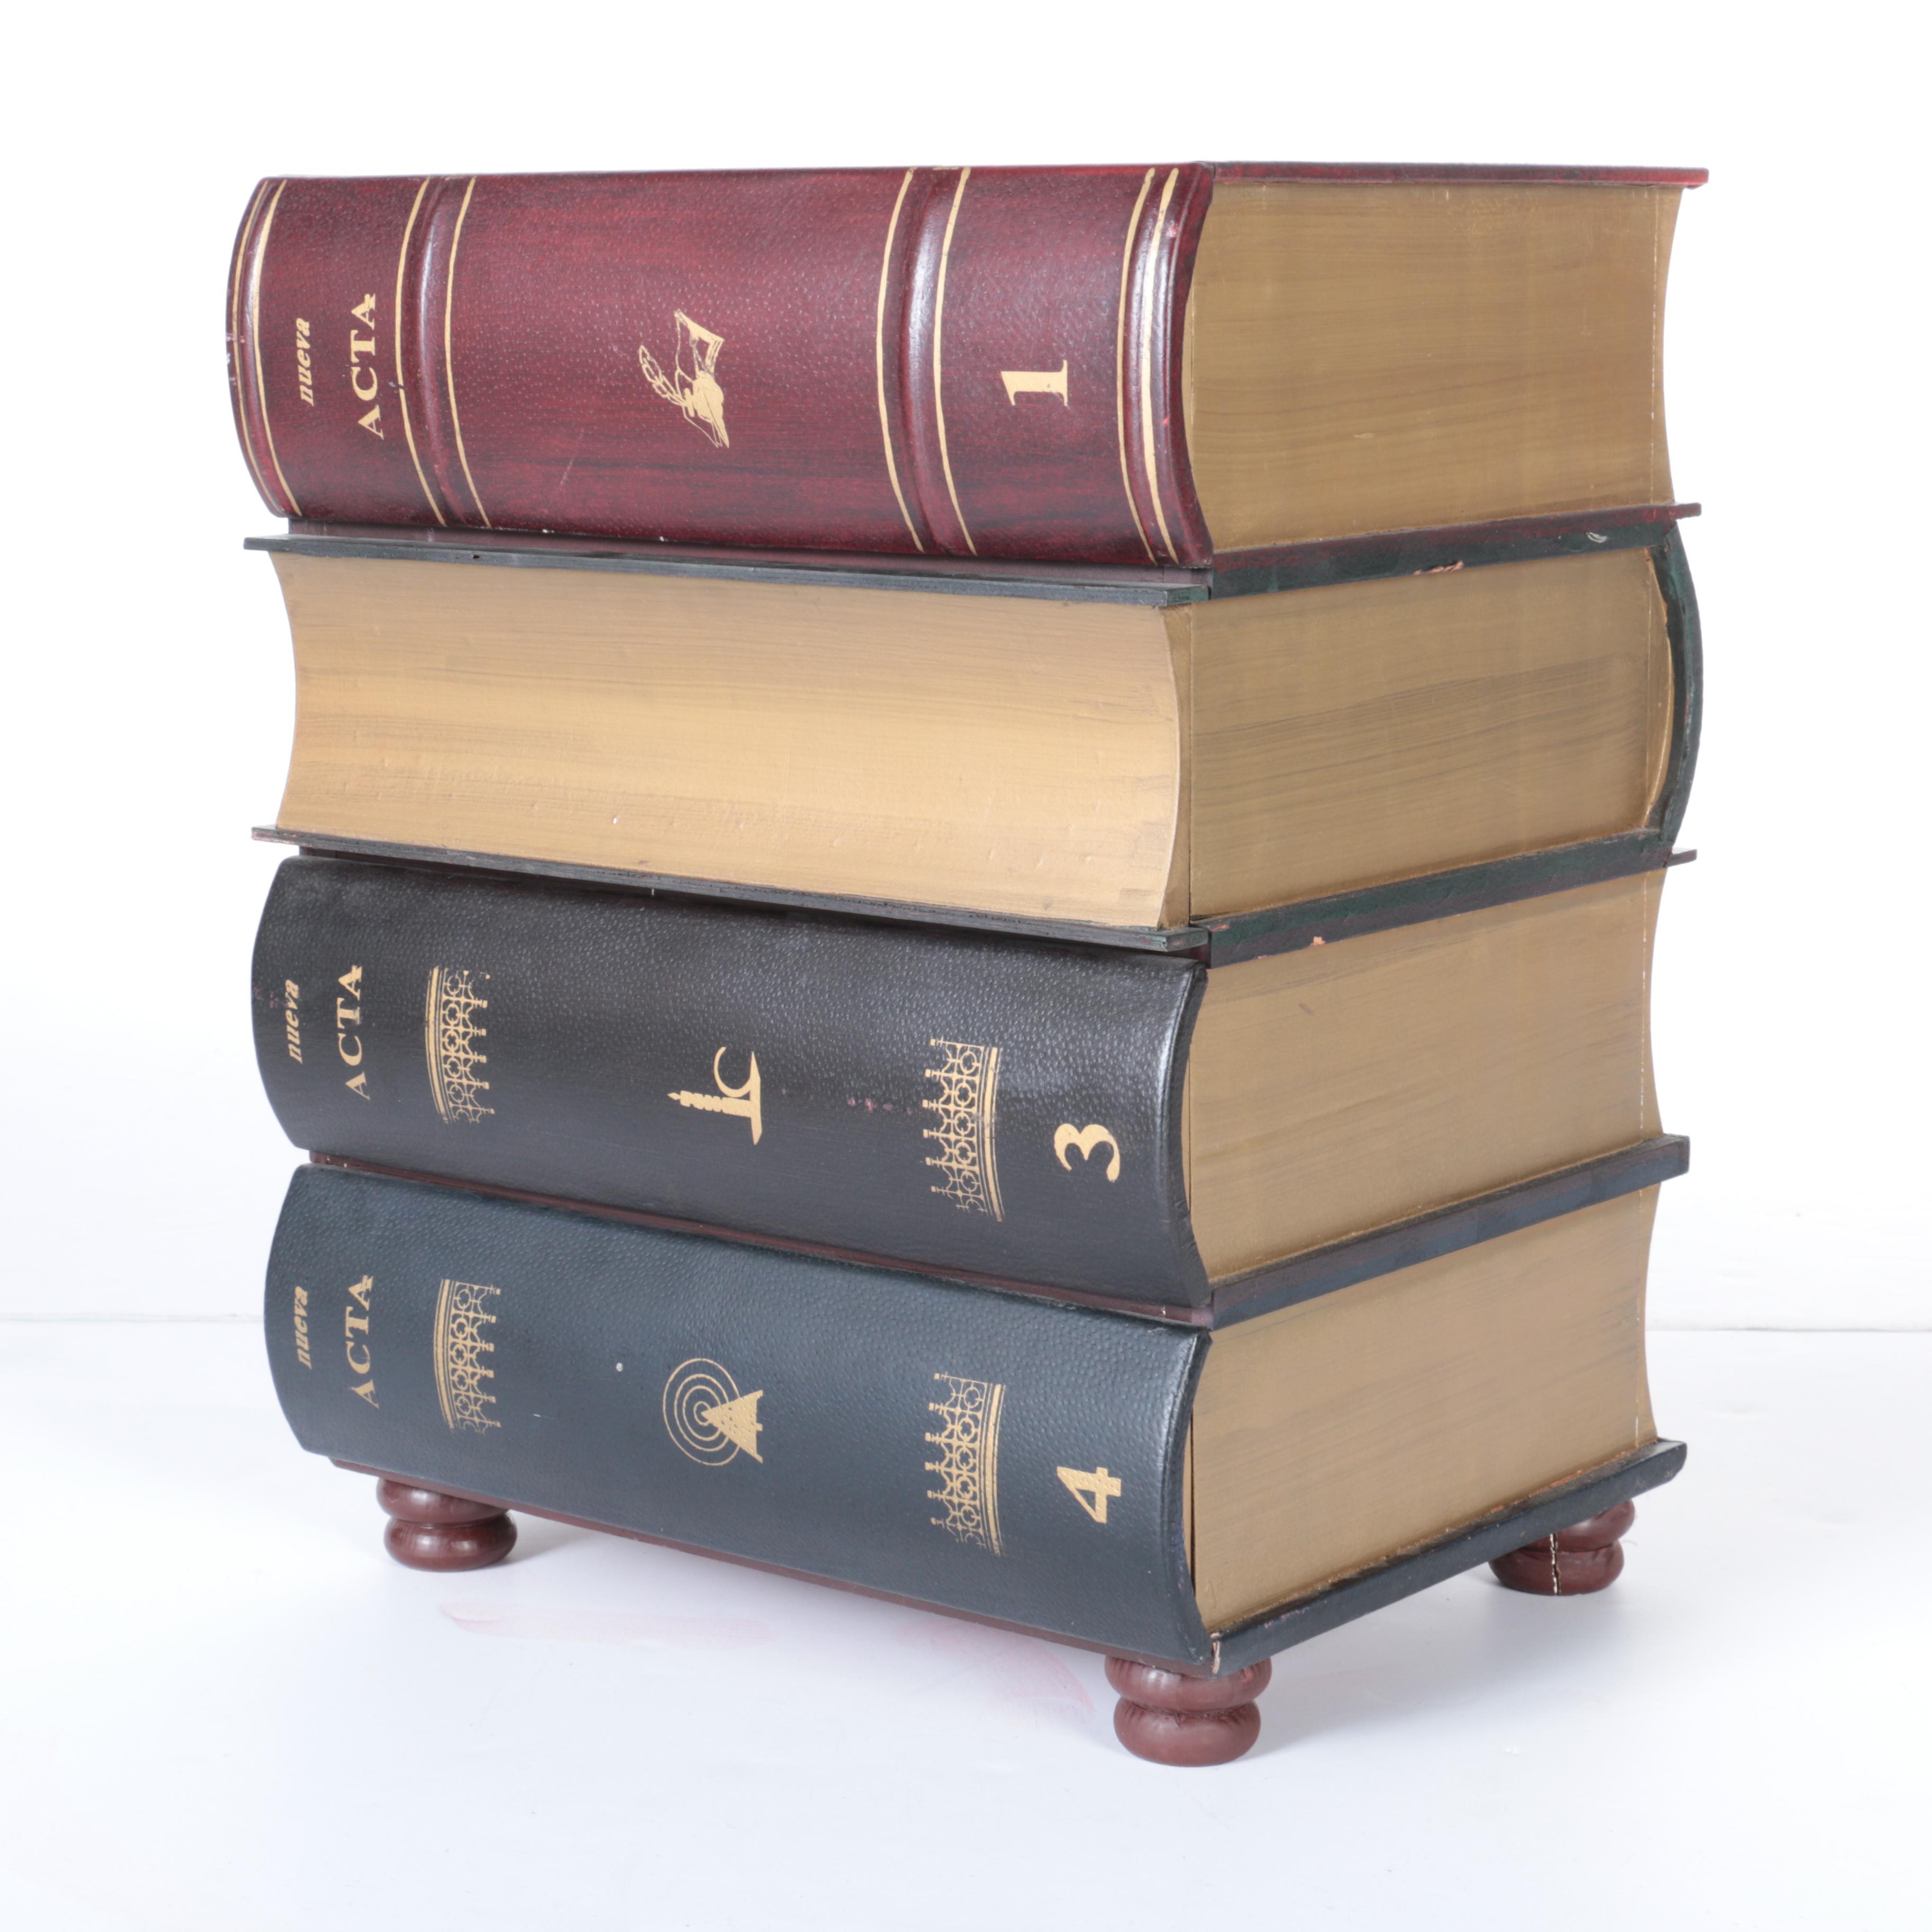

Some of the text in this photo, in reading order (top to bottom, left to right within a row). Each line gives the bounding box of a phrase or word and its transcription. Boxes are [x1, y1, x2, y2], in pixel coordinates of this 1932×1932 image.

[296, 318, 314, 406] nueva
[350, 293, 383, 440] ACTA
[999, 359, 1069, 408] 1
[284, 979, 302, 1063] nueva
[337, 965, 370, 1100] ACTA
[1054, 1123, 1121, 1183] 3
[293, 1285, 312, 1370] nueva
[345, 1275, 379, 1409] ACTA
[1057, 1466, 1122, 1524] 4
